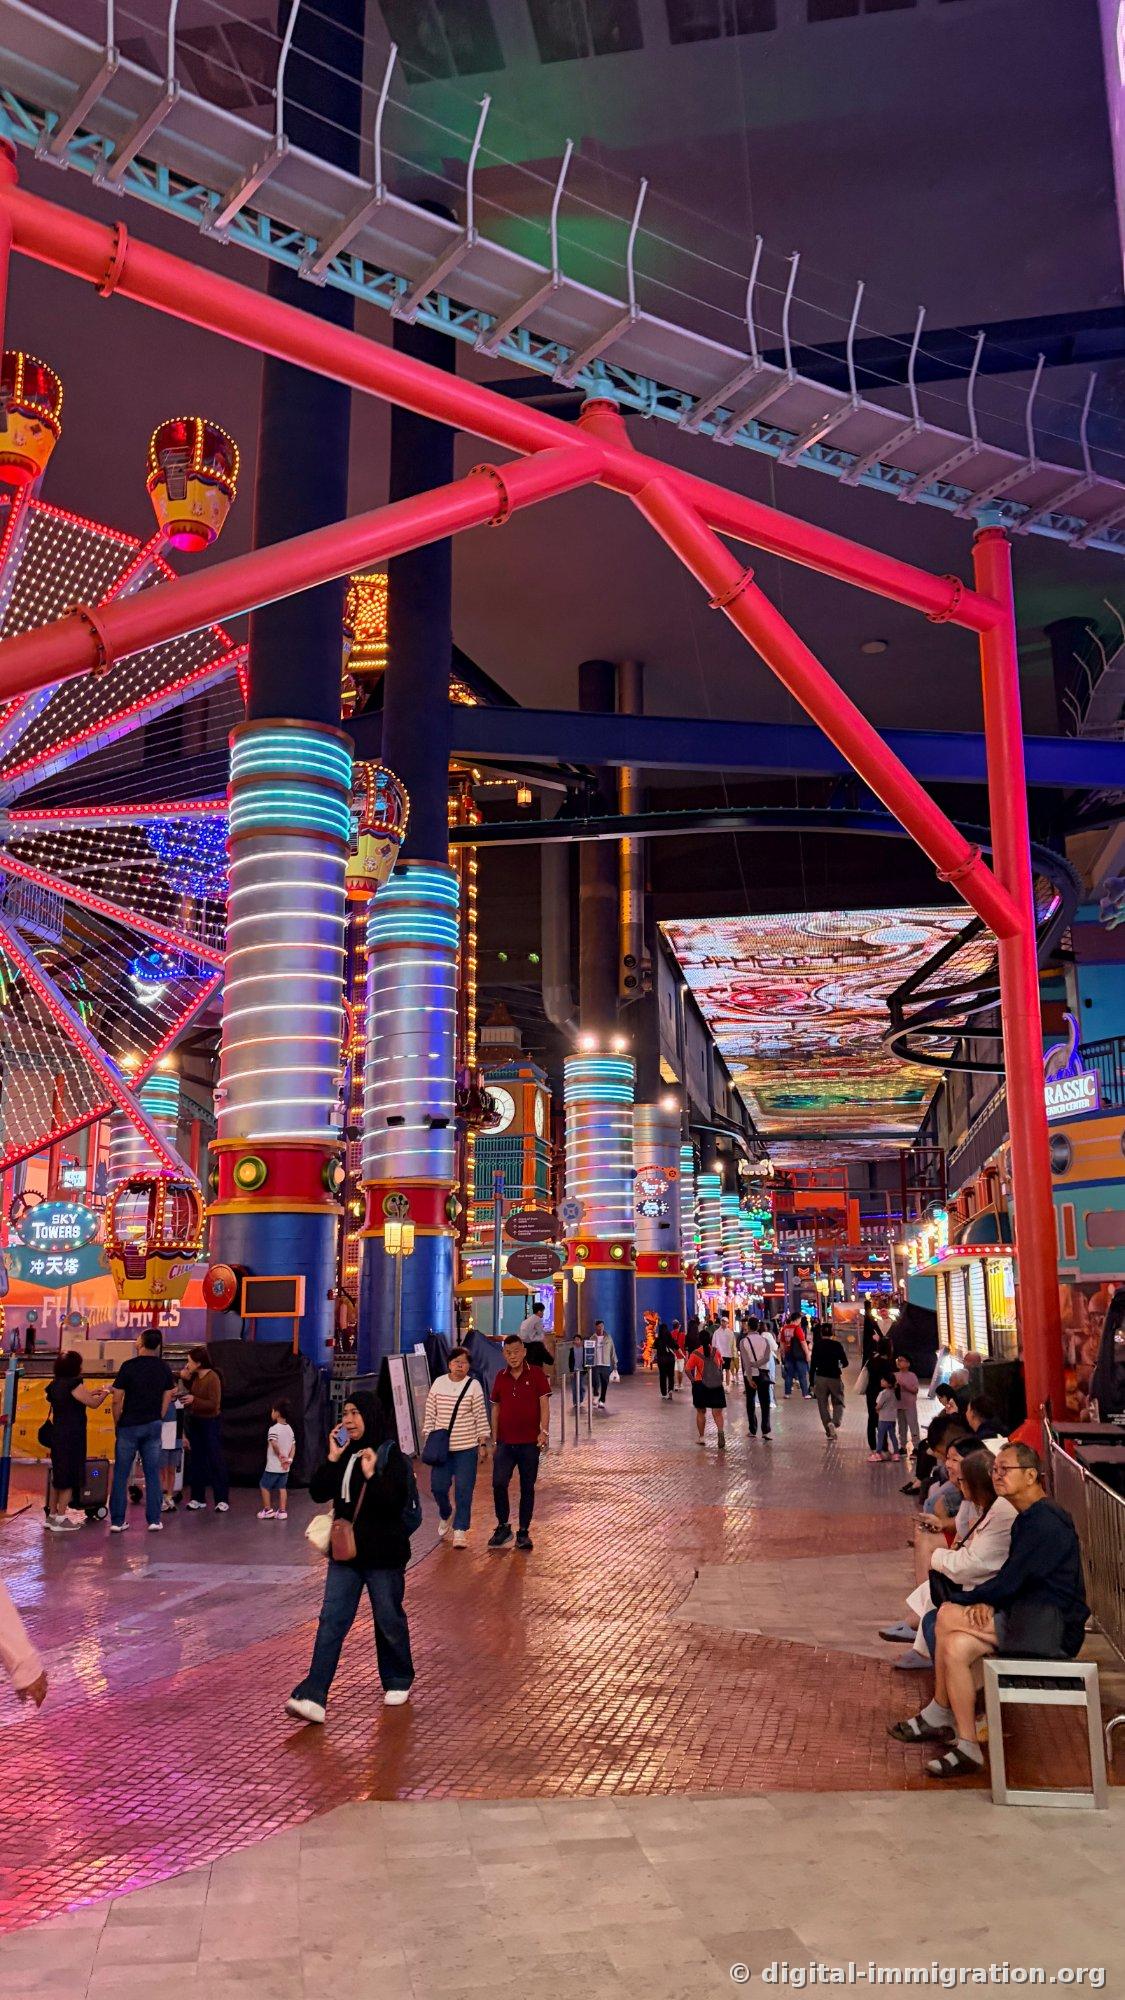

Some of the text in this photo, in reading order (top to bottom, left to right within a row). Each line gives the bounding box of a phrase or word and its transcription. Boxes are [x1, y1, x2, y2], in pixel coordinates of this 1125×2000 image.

[1044, 1075, 1096, 1106] RASSIC
[1065, 1099, 1090, 1111] CENTER
[51, 1213, 79, 1225] SKY
[31, 1222, 81, 1239] TOWERS
[29, 1256, 79, 1275] 冲天塔
